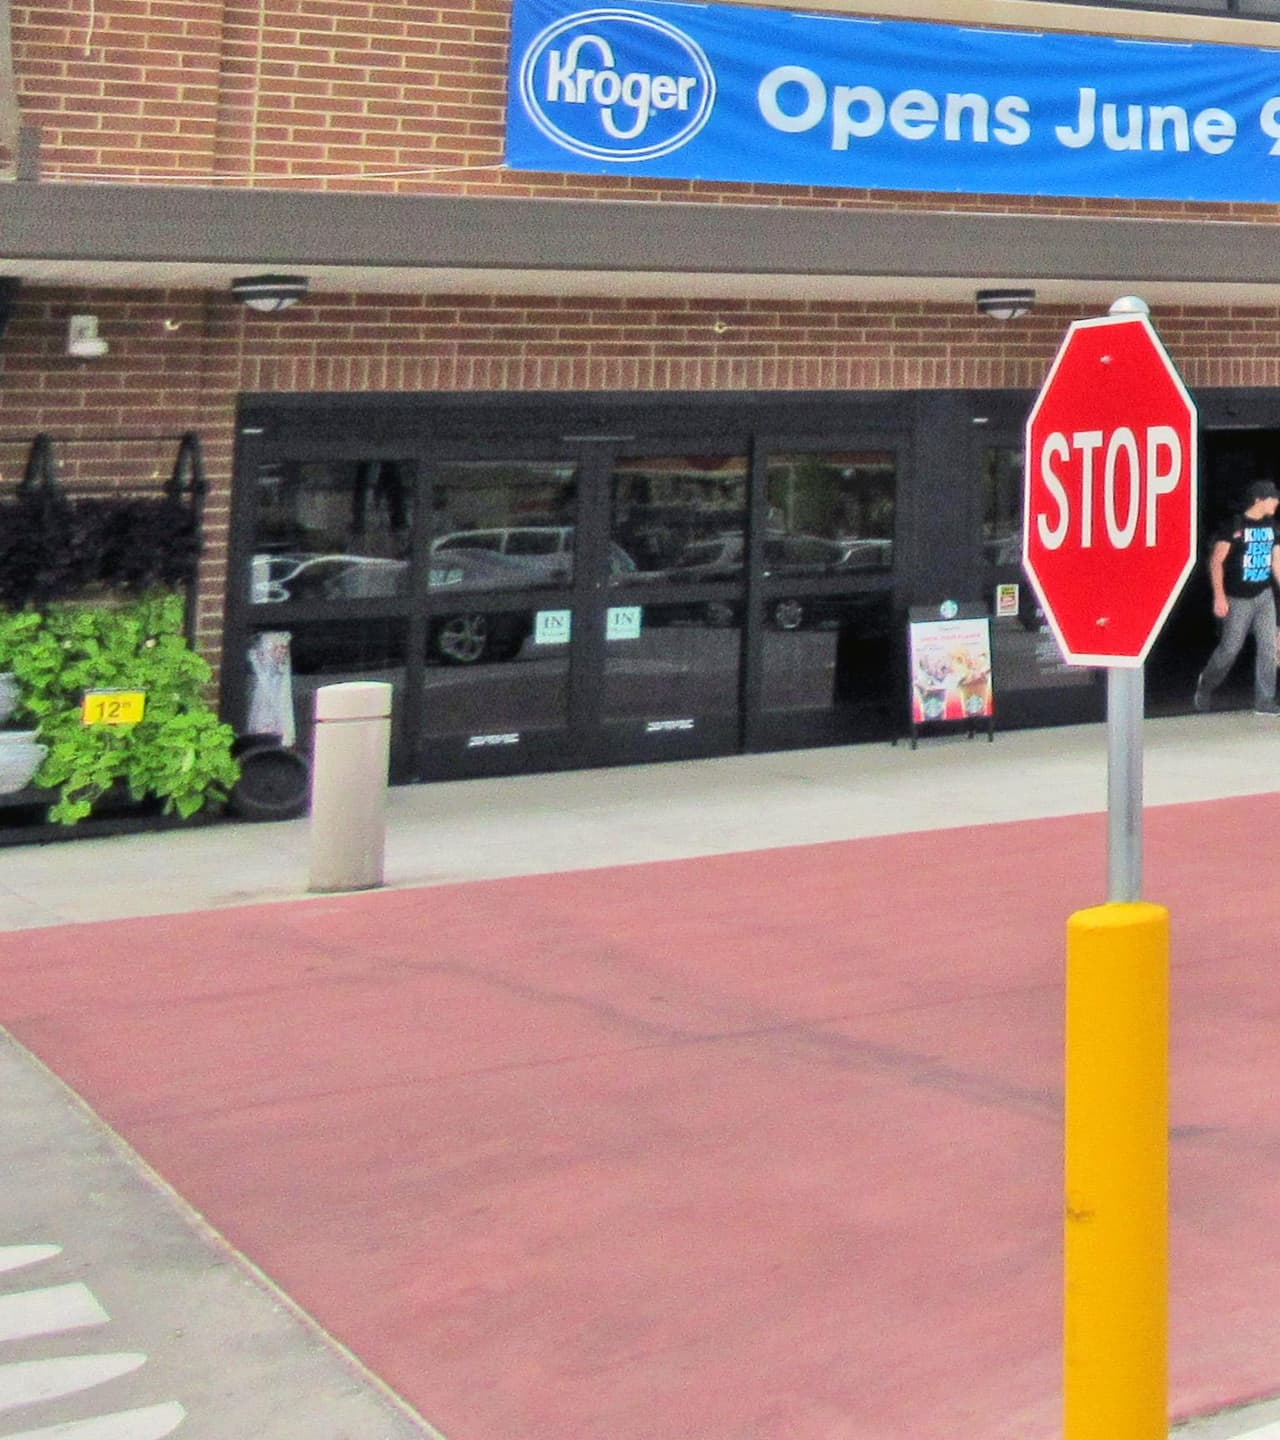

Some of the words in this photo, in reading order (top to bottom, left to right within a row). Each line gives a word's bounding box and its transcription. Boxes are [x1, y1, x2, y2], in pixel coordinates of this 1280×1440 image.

[546, 33, 697, 140] Kroger
[758, 65, 1033, 151] Opens
[1055, 87, 1237, 156] June
[1037, 425, 1183, 551] STOP
